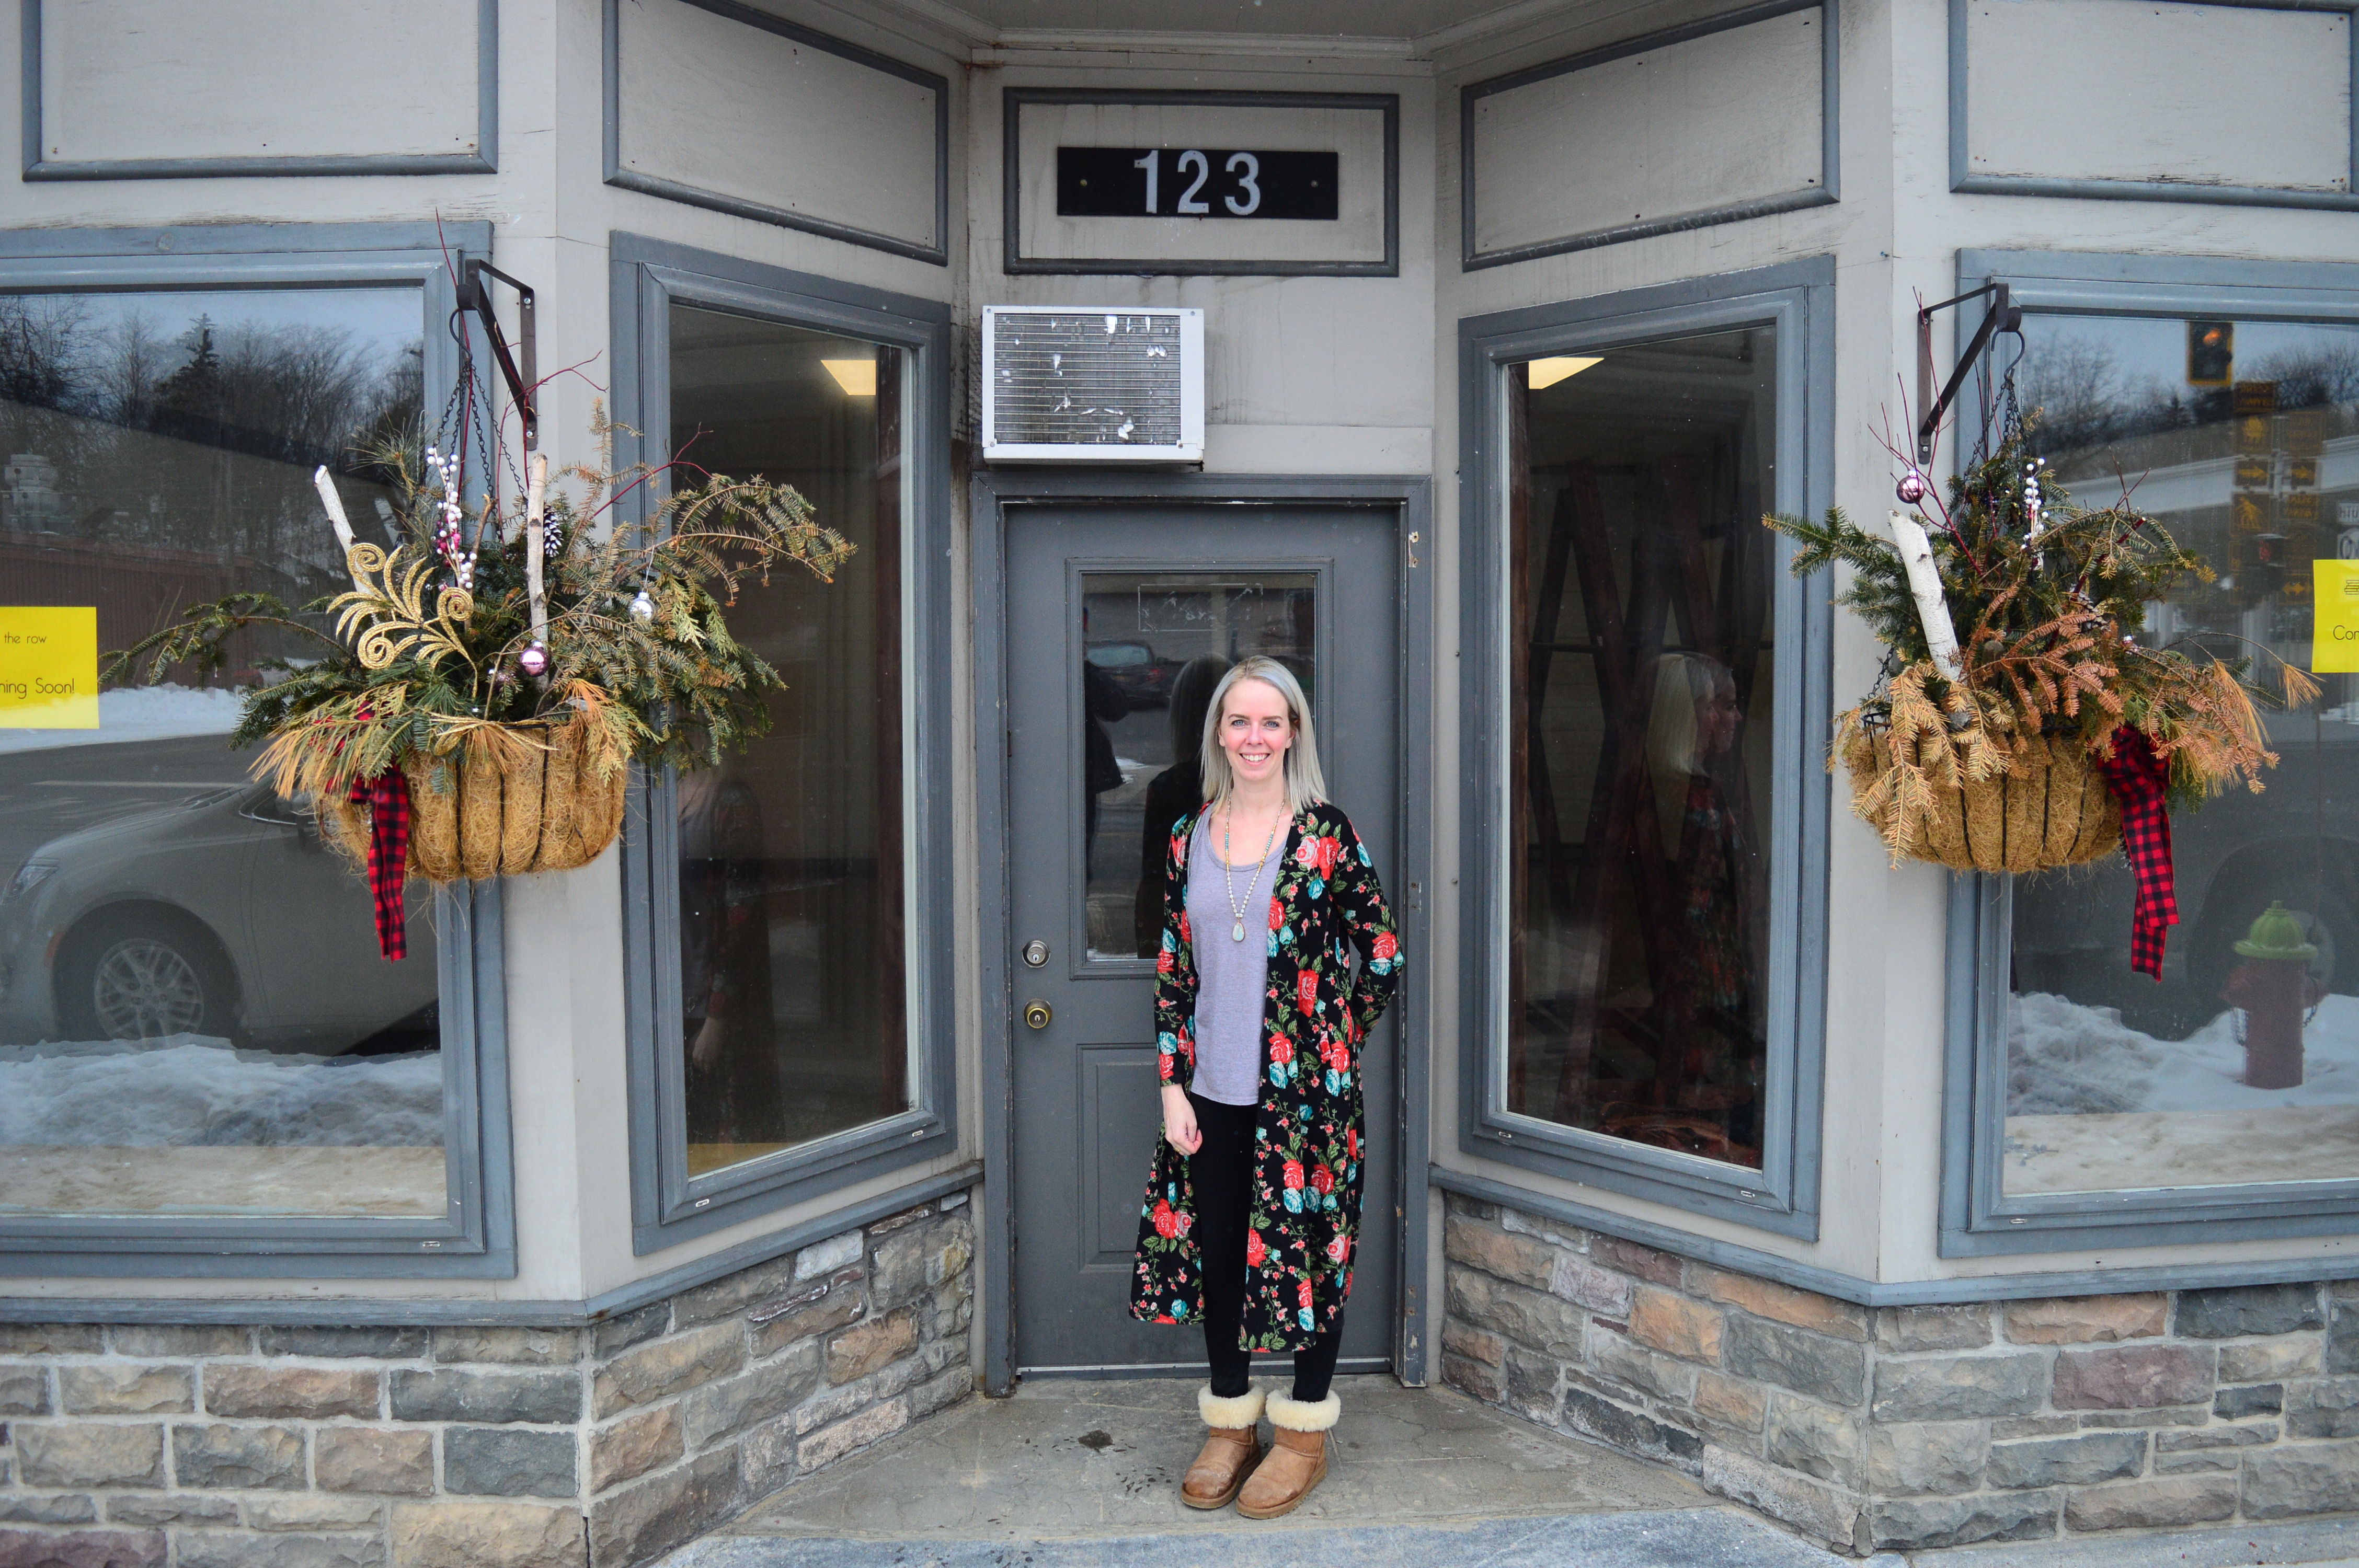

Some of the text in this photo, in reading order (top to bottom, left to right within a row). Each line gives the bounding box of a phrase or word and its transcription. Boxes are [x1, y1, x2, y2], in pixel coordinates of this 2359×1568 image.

[1133, 149, 1261, 215] 123
[4, 631, 47, 644] the row
[35, 677, 74, 694] Soon!
